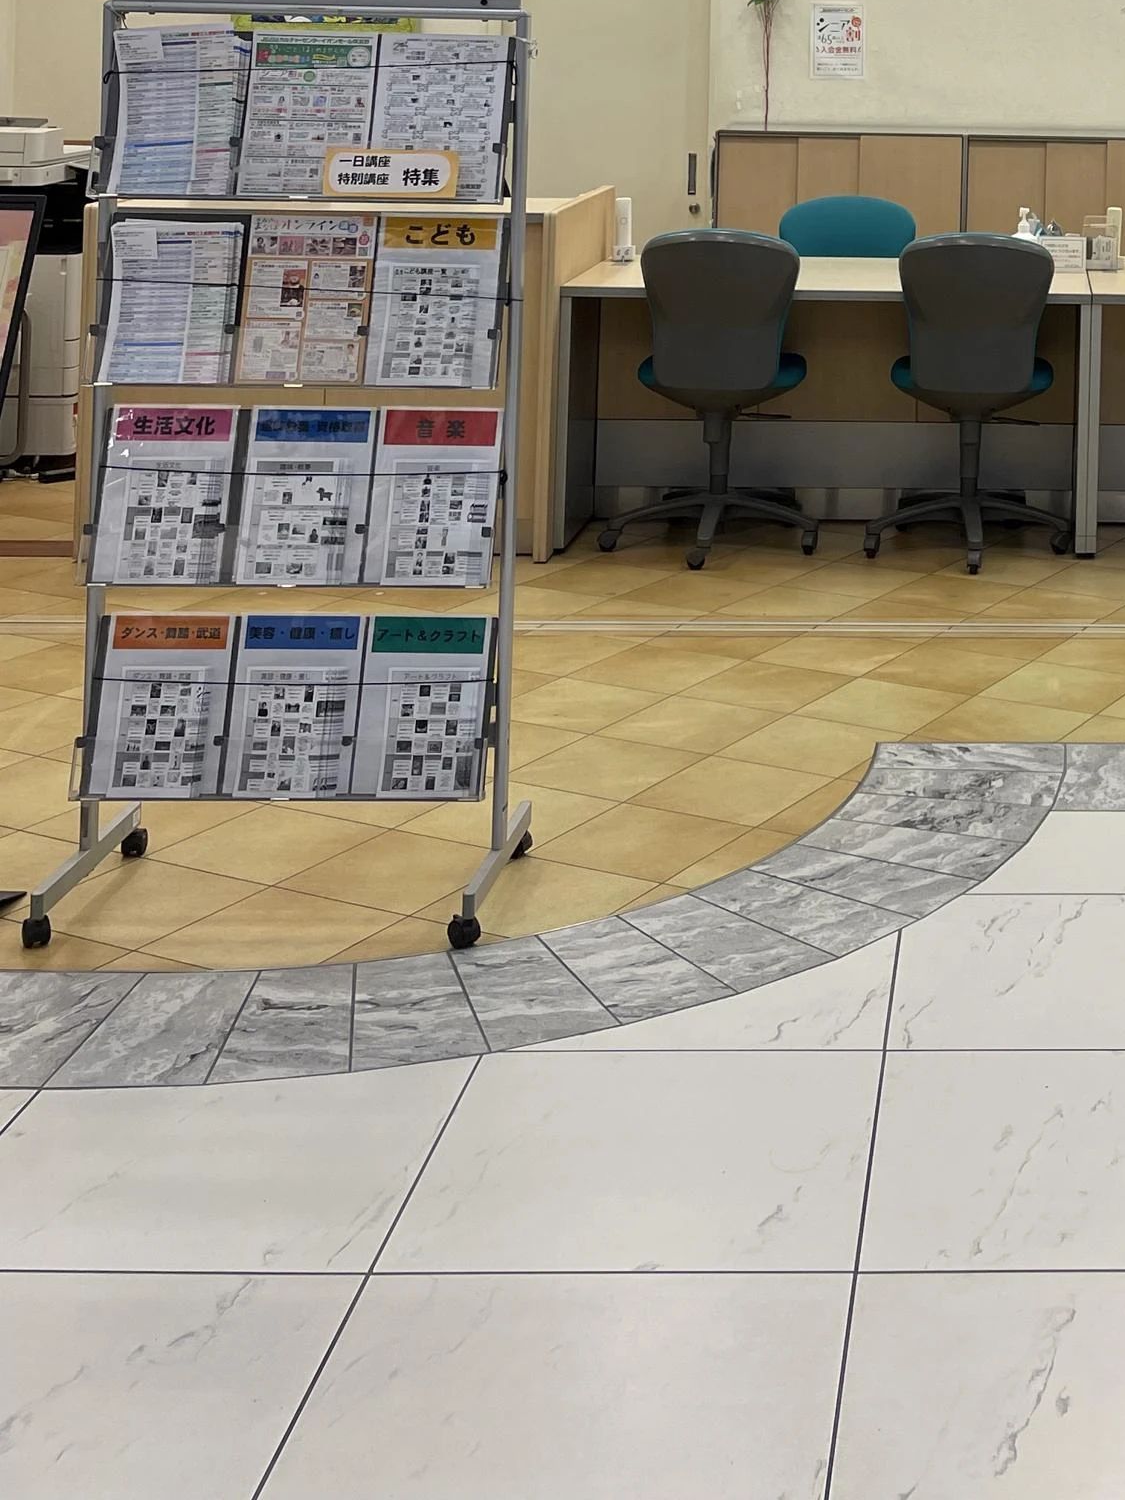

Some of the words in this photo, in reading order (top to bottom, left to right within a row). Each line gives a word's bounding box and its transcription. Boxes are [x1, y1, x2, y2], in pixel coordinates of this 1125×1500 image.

[339, 155, 391, 168] 一日講座
[337, 172, 390, 185] 特別講座
[402, 167, 440, 186] 特集
[405, 224, 475, 246] こども
[132, 416, 215, 436] 生活文化
